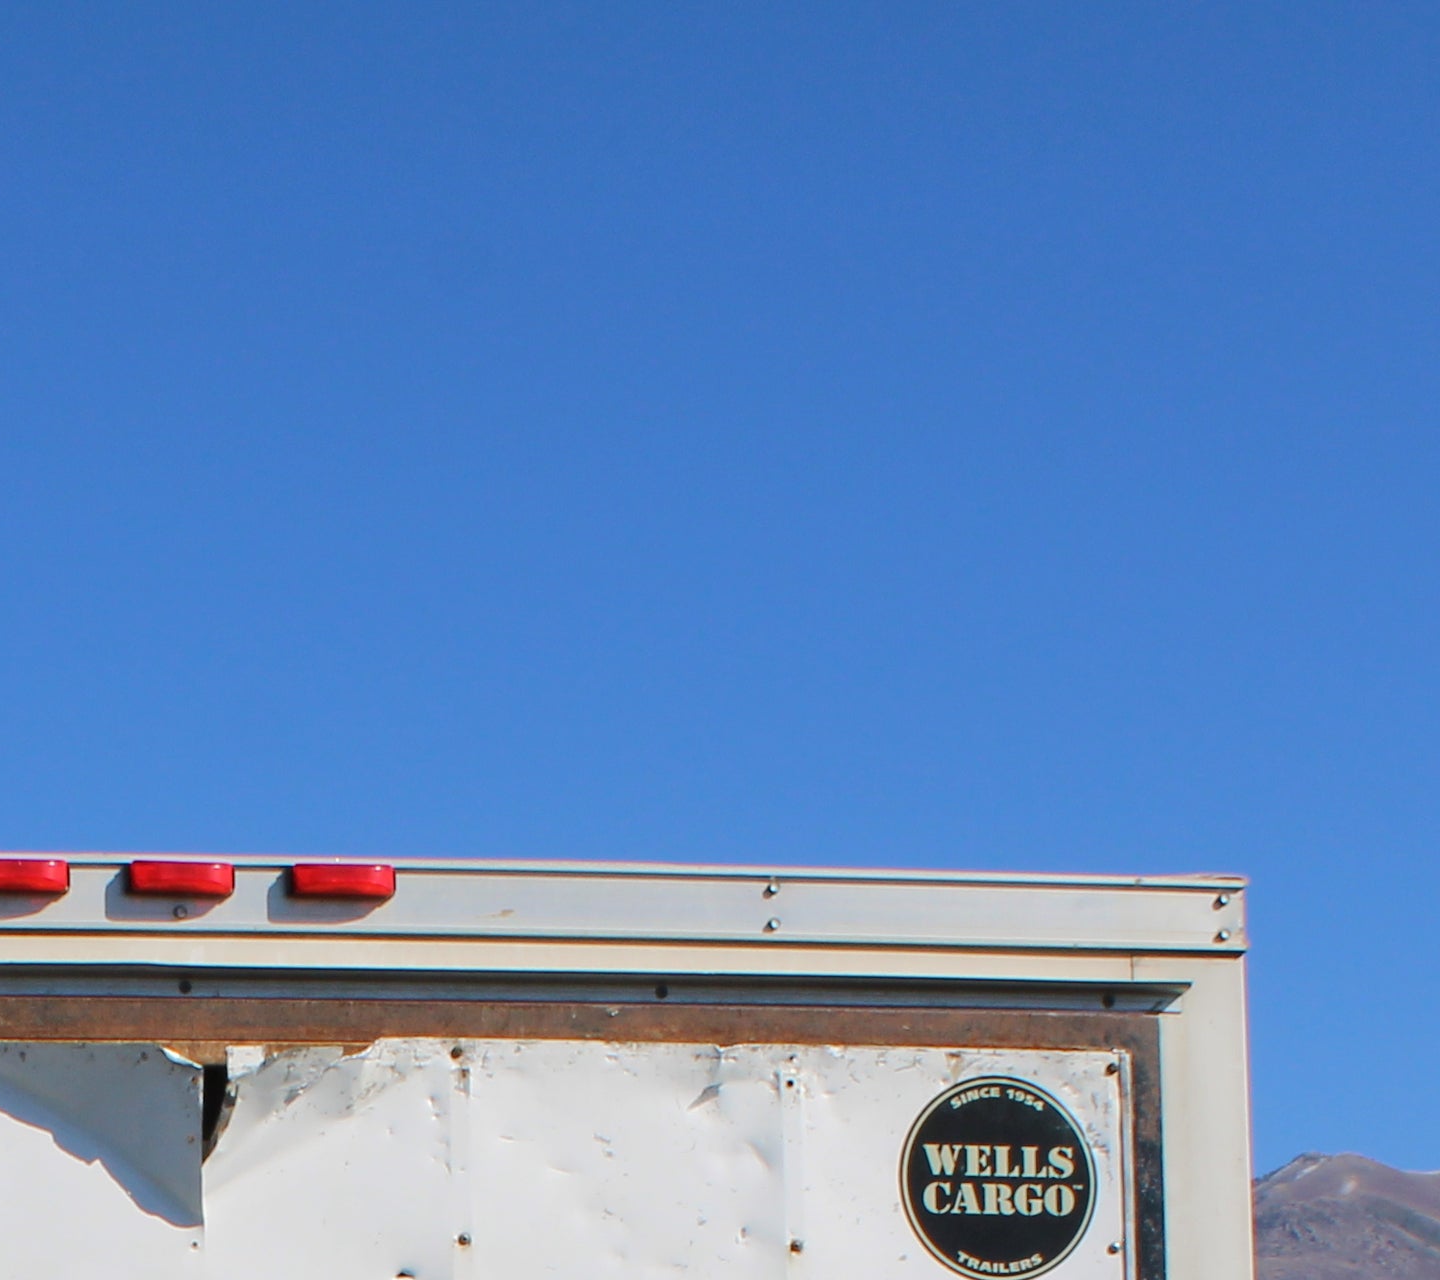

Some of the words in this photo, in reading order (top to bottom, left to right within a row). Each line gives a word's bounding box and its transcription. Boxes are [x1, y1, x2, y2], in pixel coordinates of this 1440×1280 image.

[950, 1086, 1000, 1109] SINCE
[1006, 1088, 1044, 1111] 1954
[922, 1143, 1074, 1179] WELLS
[922, 1182, 1075, 1217] CARGO
[957, 1251, 1043, 1273] TRAILERS
